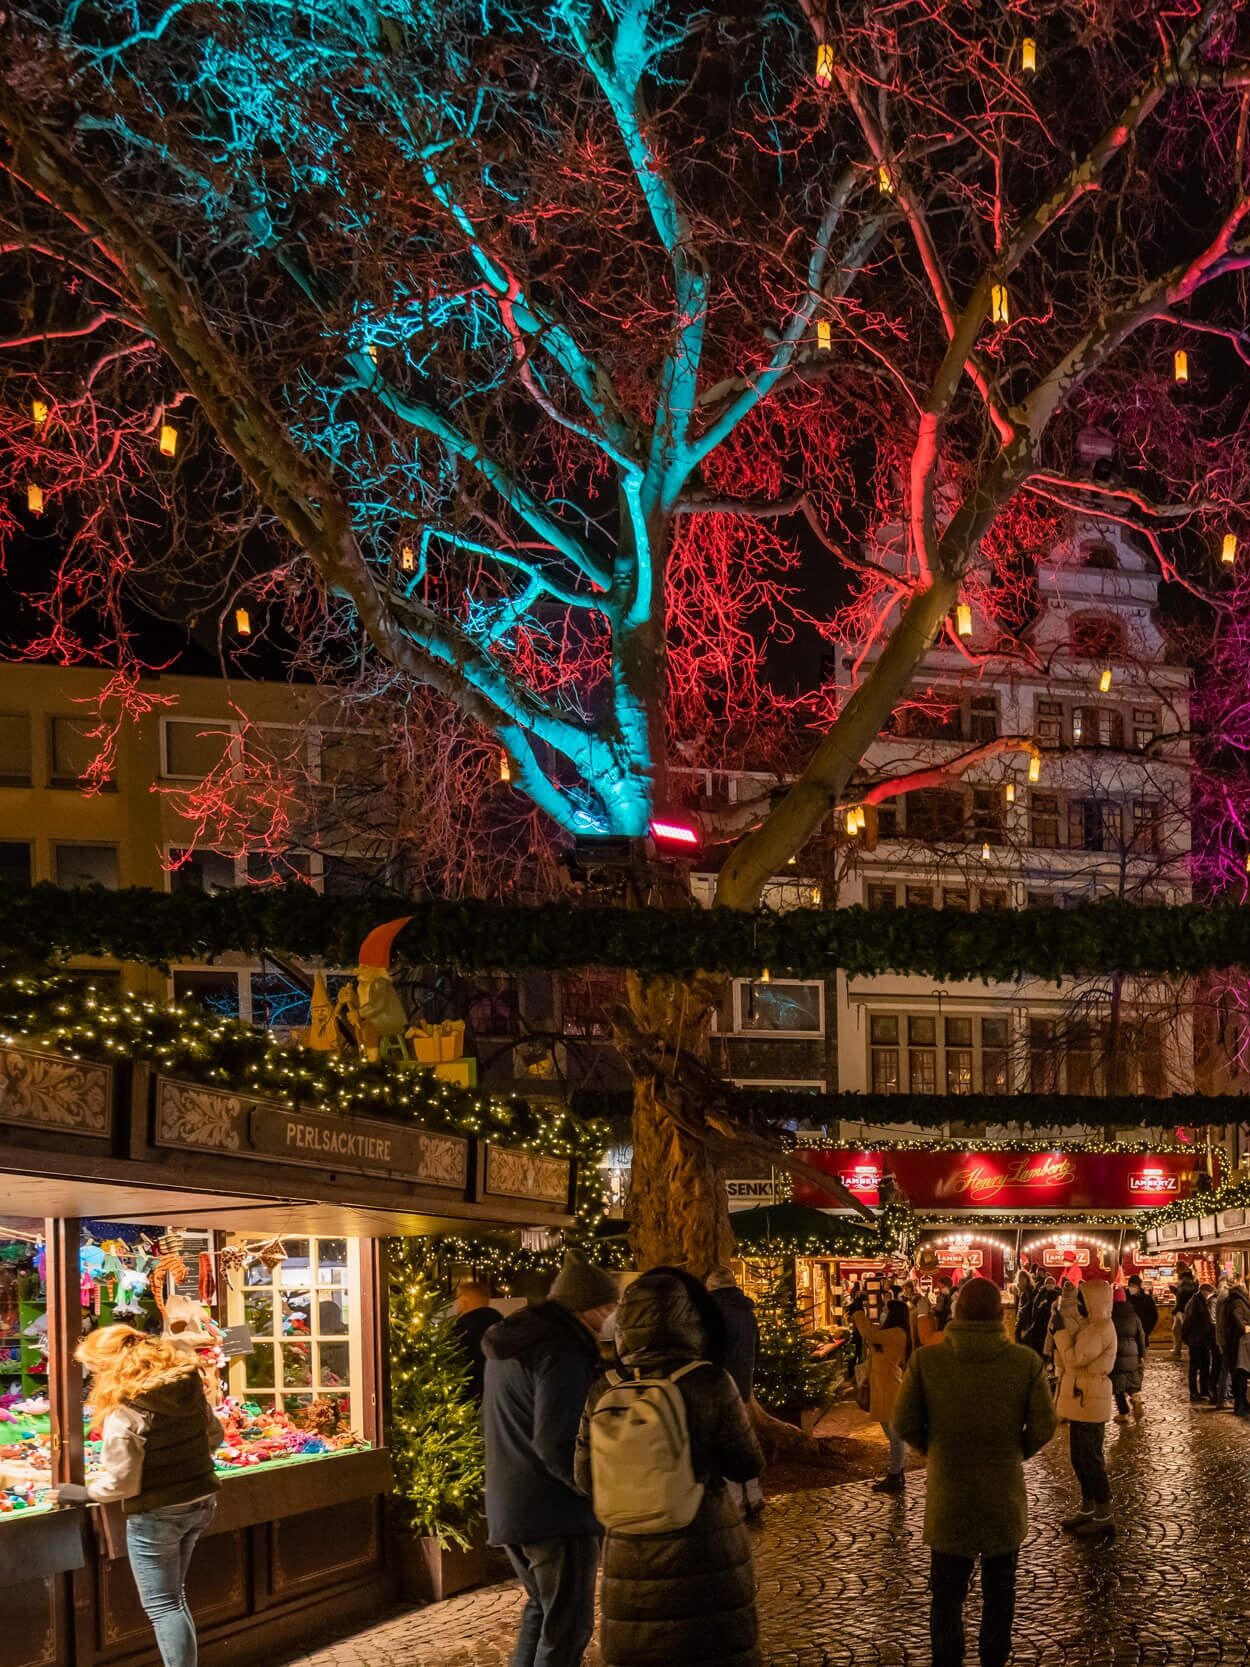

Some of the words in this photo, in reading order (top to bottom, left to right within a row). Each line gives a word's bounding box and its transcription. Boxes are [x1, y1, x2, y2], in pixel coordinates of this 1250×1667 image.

[286, 1122, 392, 1161] PERLSACKTIERE
[841, 1175, 882, 1188] LAMBERT
[1130, 1177, 1177, 1189] LAMBERTZ
